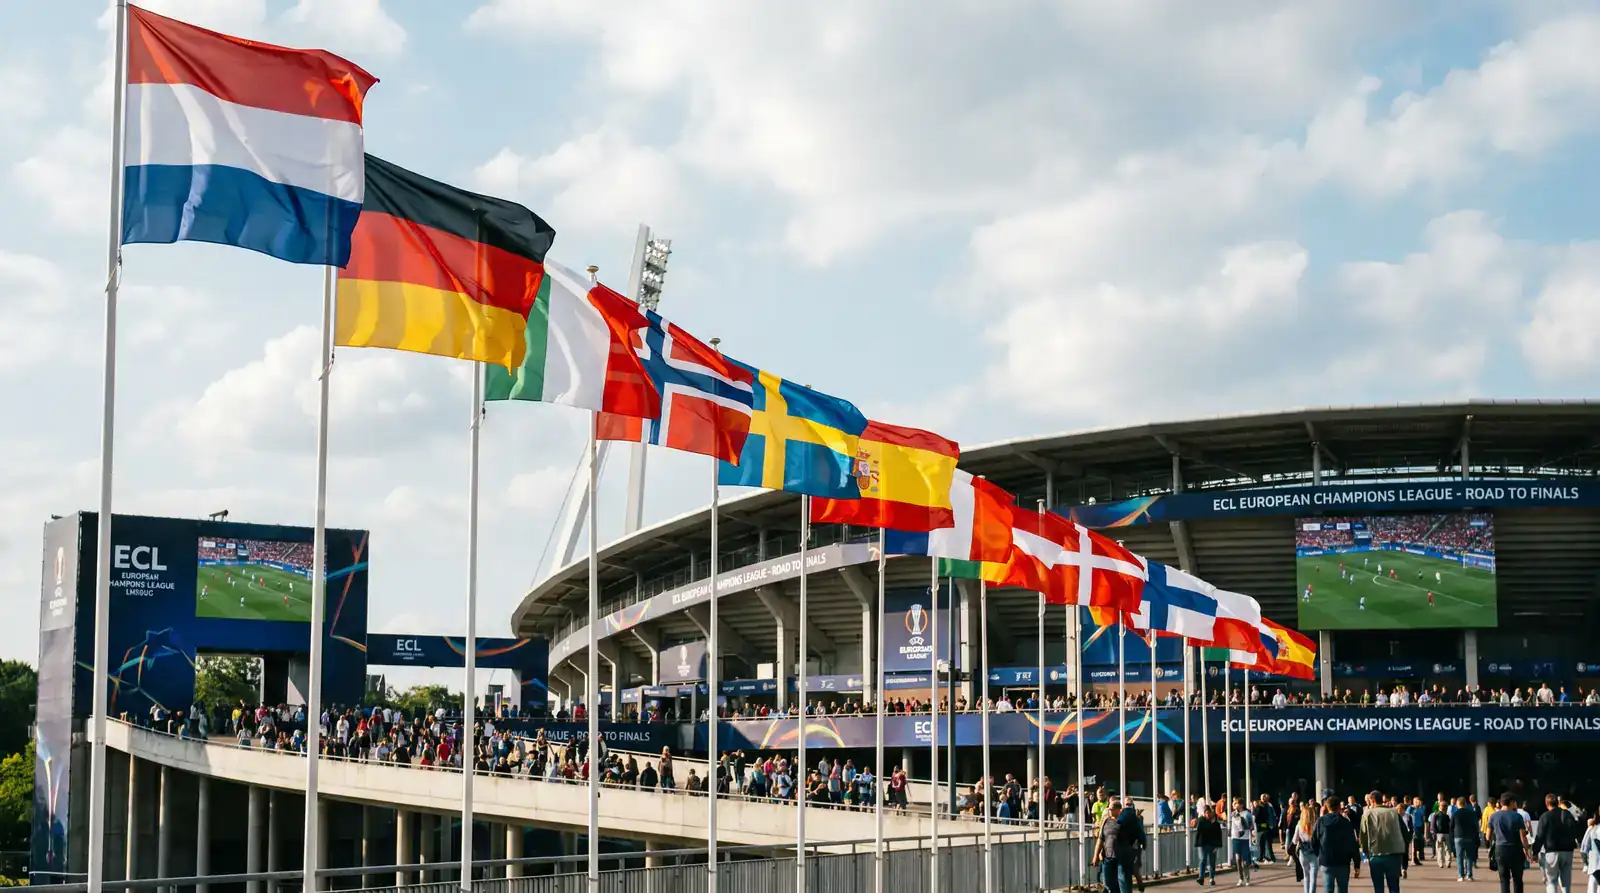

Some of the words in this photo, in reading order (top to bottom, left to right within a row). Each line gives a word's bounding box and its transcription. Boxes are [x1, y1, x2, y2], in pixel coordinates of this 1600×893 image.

[1213, 499, 1236, 510] ECL
[1240, 494, 1310, 509] EUROPEAN
[1314, 490, 1395, 505] CHAMPIONS
[1399, 488, 1453, 501] LEAGUE
[1465, 488, 1504, 500] ROAD
[1508, 487, 1527, 499] TO
[1531, 487, 1579, 499] FINALS
[114, 545, 168, 571] ECL
[708, 573, 743, 594] CAMPIONS
[772, 562, 791, 576] ROAD
[806, 553, 826, 568] INALS
[108, 580, 145, 588] HAMPONS
[147, 581, 175, 589] LEAGUE
[396, 638, 422, 651] ECL
[1249, 719, 1323, 731] EUROPEAN
[1326, 718, 1412, 731] CHAMPIONS
[1415, 718, 1472, 731] LEAGUE
[1484, 718, 1524, 730] ROAD
[1527, 717, 1547, 730] TO
[1551, 717, 1600, 730] FINALS
[605, 731, 617, 740] TO
[619, 731, 650, 741] FINALS
